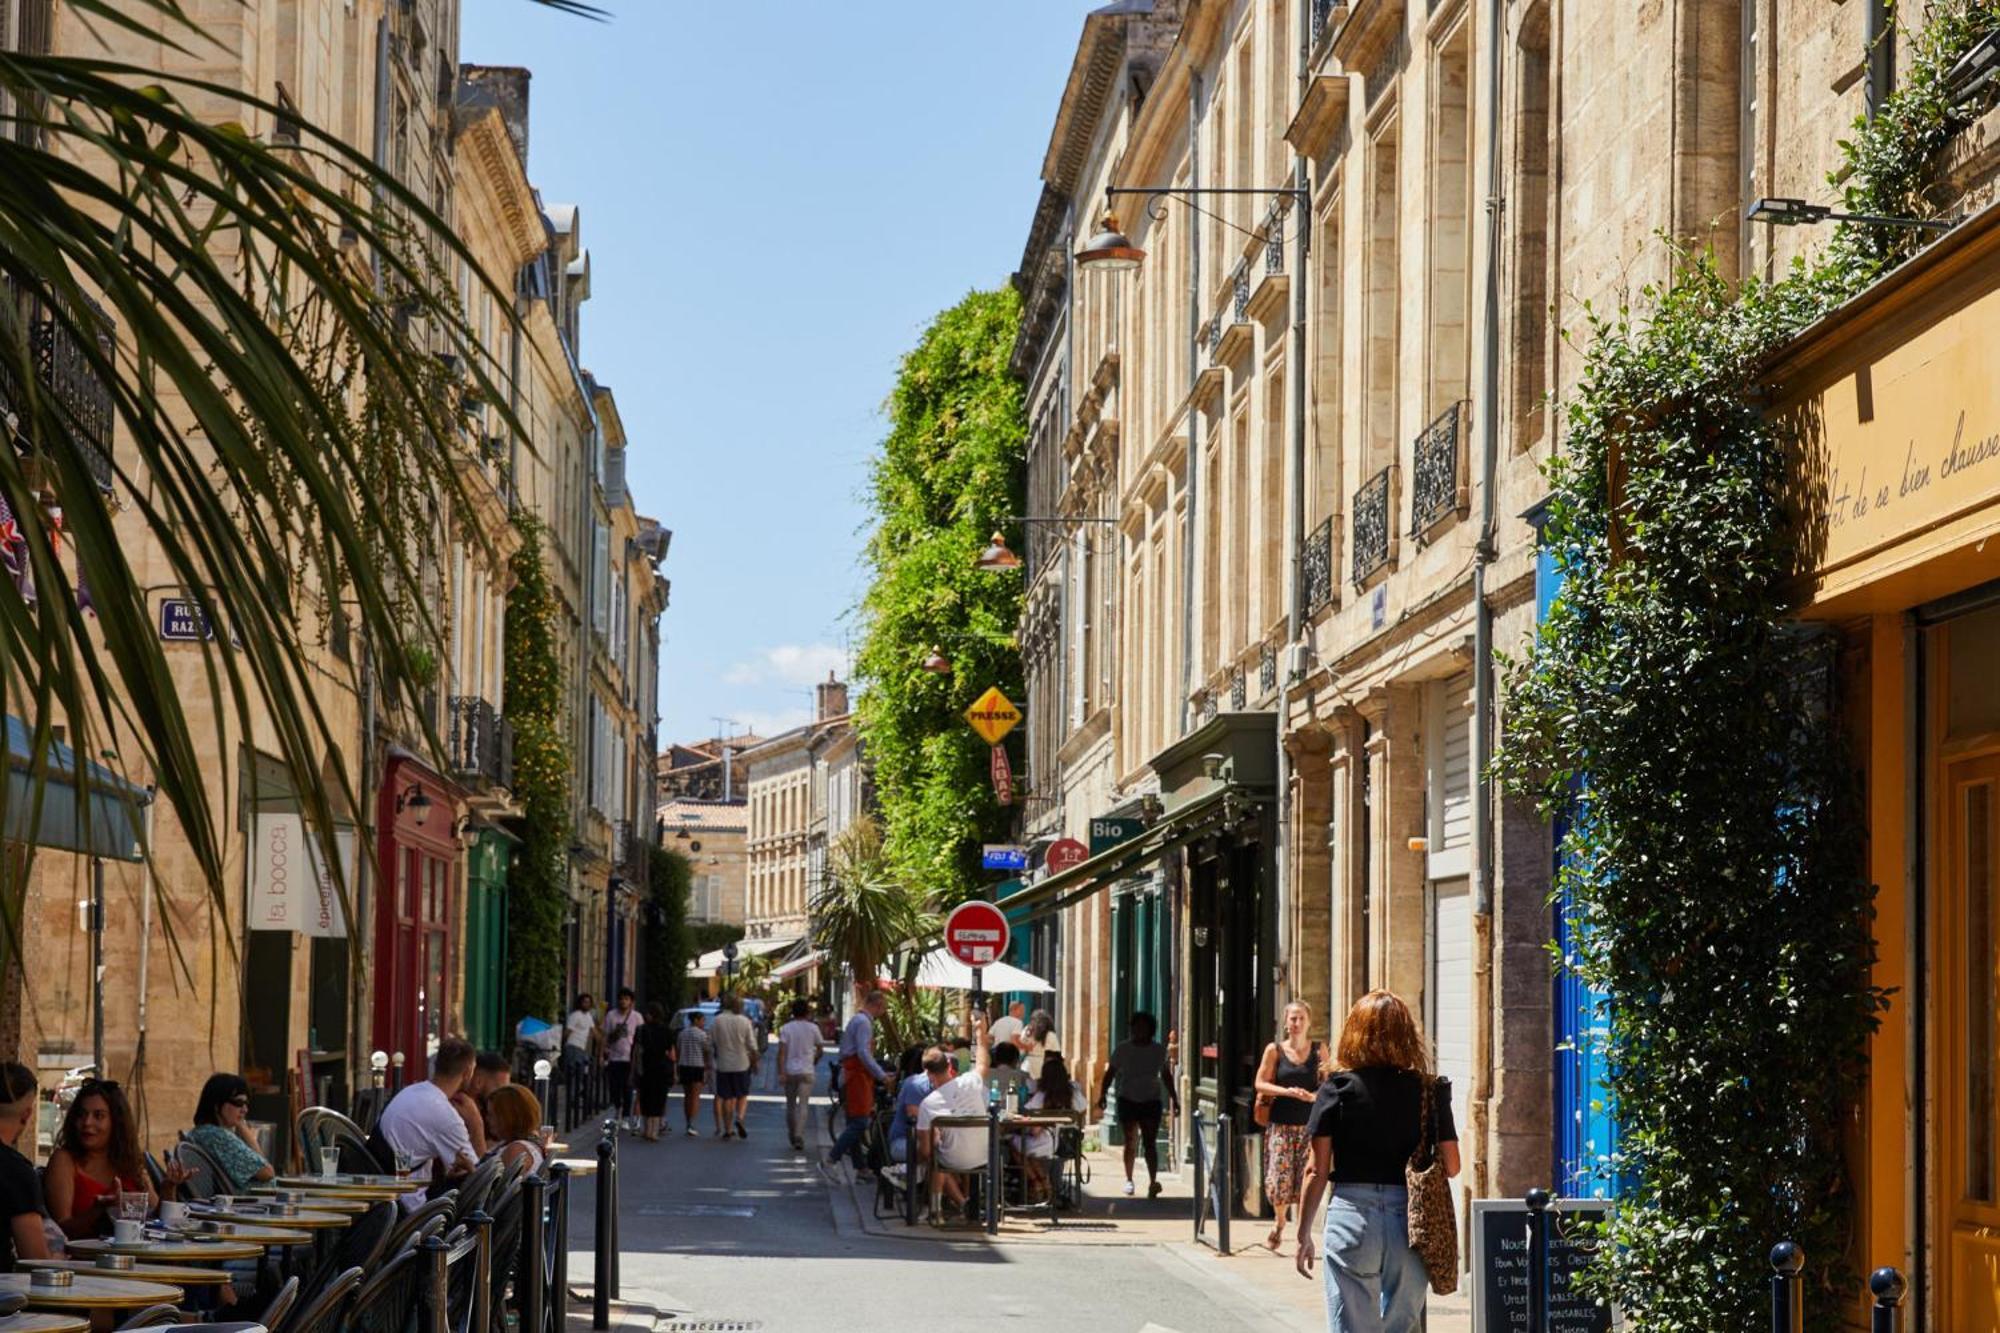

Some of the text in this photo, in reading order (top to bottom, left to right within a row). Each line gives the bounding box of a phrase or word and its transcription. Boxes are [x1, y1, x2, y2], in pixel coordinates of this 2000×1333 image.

[1853, 465, 1868, 520] de
[1874, 485, 1889, 510] se
[1899, 439, 1931, 498] bien
[171, 620, 203, 633] RAZ
[970, 711, 1017, 721] PRESSE
[993, 746, 1010, 801] TABAC
[1092, 822, 1123, 838] Bio
[267, 823, 288, 922] la bocca
